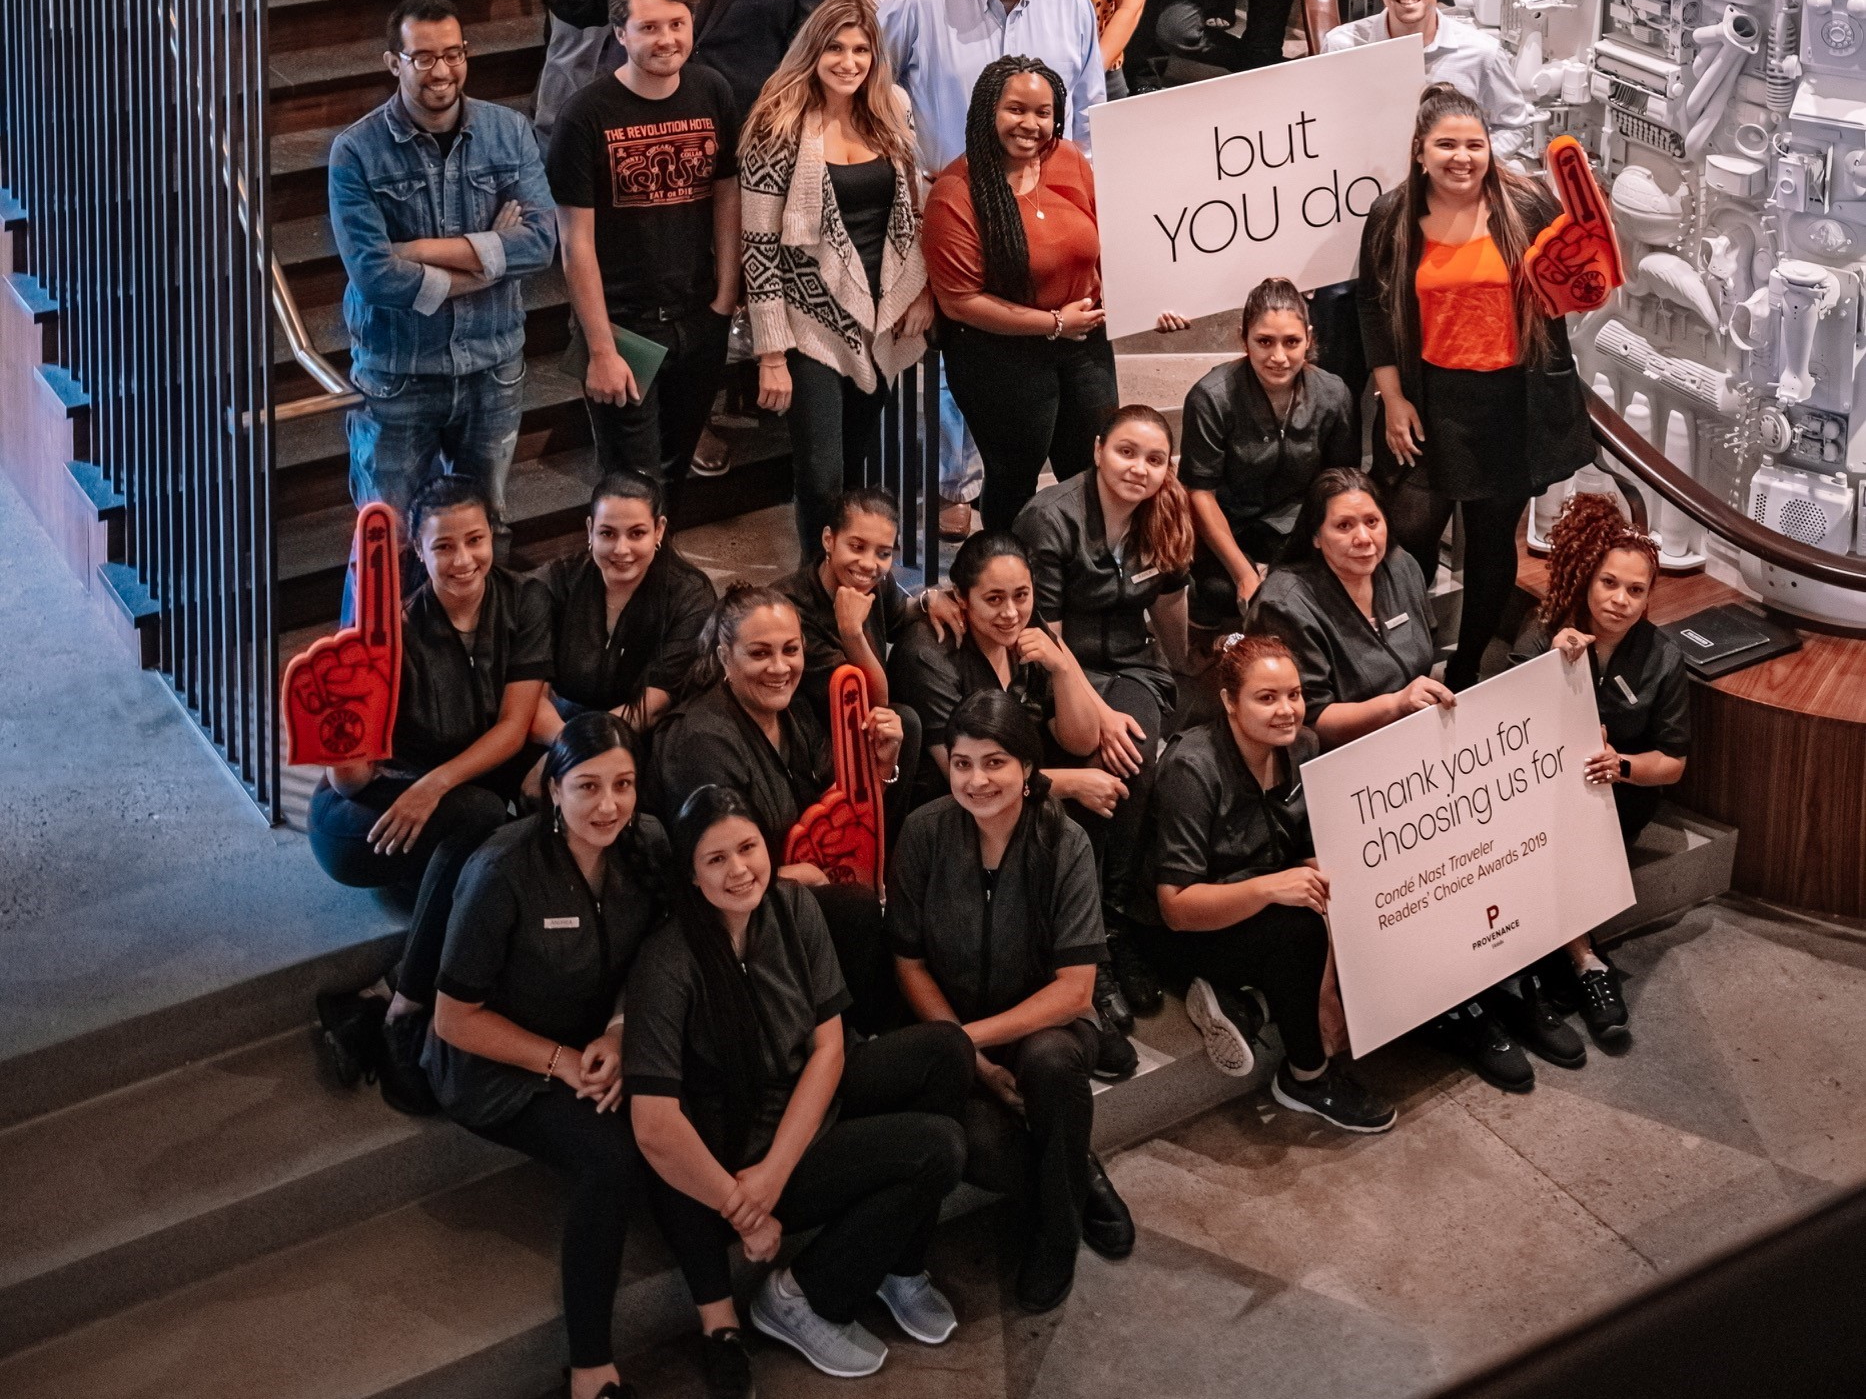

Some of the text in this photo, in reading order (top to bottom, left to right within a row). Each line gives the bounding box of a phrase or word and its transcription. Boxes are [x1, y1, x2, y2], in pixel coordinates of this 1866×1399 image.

[604, 118, 715, 141] THE REVOLUTION HOTEL
[680, 150, 703, 158] COLLAB
[1213, 111, 1319, 181] but
[650, 190, 664, 199] EAT
[678, 187, 693, 196] DIE
[1153, 169, 1383, 263] YOU do
[1350, 717, 1532, 824] Thank you for
[1362, 745, 1566, 868] choosing us for
[1375, 839, 1495, 909] Condé Nast Traveler
[1434, 873, 1475, 902] Choice
[1478, 849, 1520, 880] Awards
[1520, 831, 1548, 858] 2019
[1472, 919, 1521, 951] PROVENANCE
[1485, 904, 1500, 929] P
